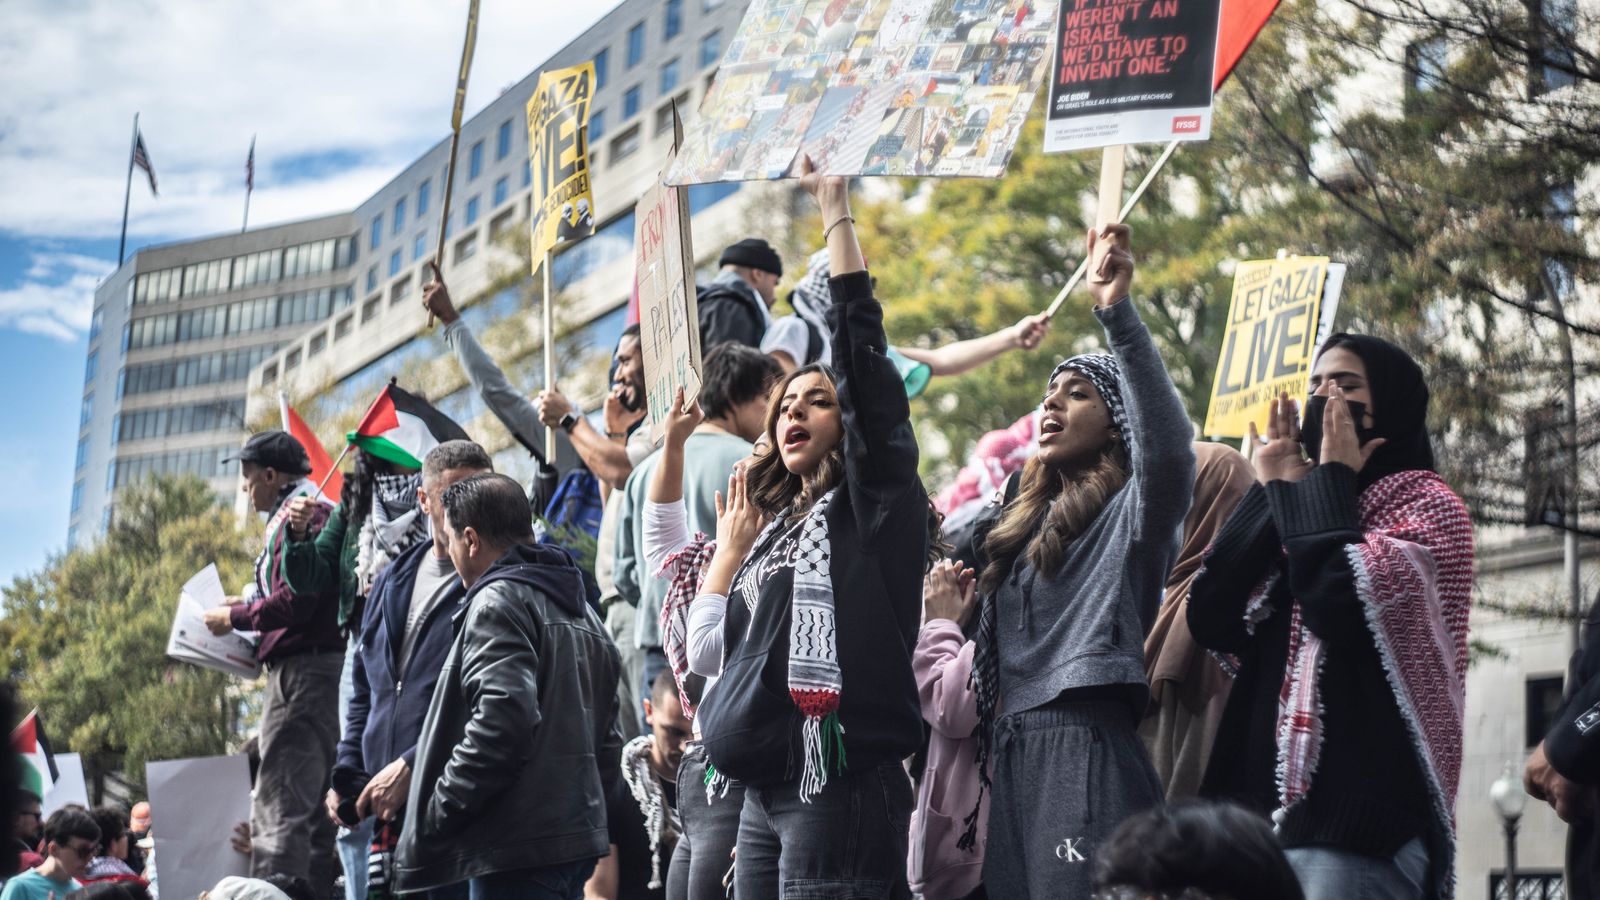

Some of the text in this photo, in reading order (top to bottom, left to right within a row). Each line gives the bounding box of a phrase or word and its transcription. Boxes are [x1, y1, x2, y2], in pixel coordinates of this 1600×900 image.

[1066, 0, 1179, 28] WEREN'T AN
[1064, 24, 1127, 47] ISRAEL,
[1062, 36, 1186, 65] WE'D HAVE TO
[1060, 60, 1124, 84] INVENT
[1057, 92, 1090, 103] JOE BIDEN
[1065, 101, 1085, 110] ISRAEL'S
[1118, 95, 1141, 103] MILITARY
[1141, 93, 1173, 101] BEACHHEAD
[1232, 285, 1267, 325] LET
[1269, 265, 1319, 311] GAZA
[1217, 301, 1315, 396] LIVE!
